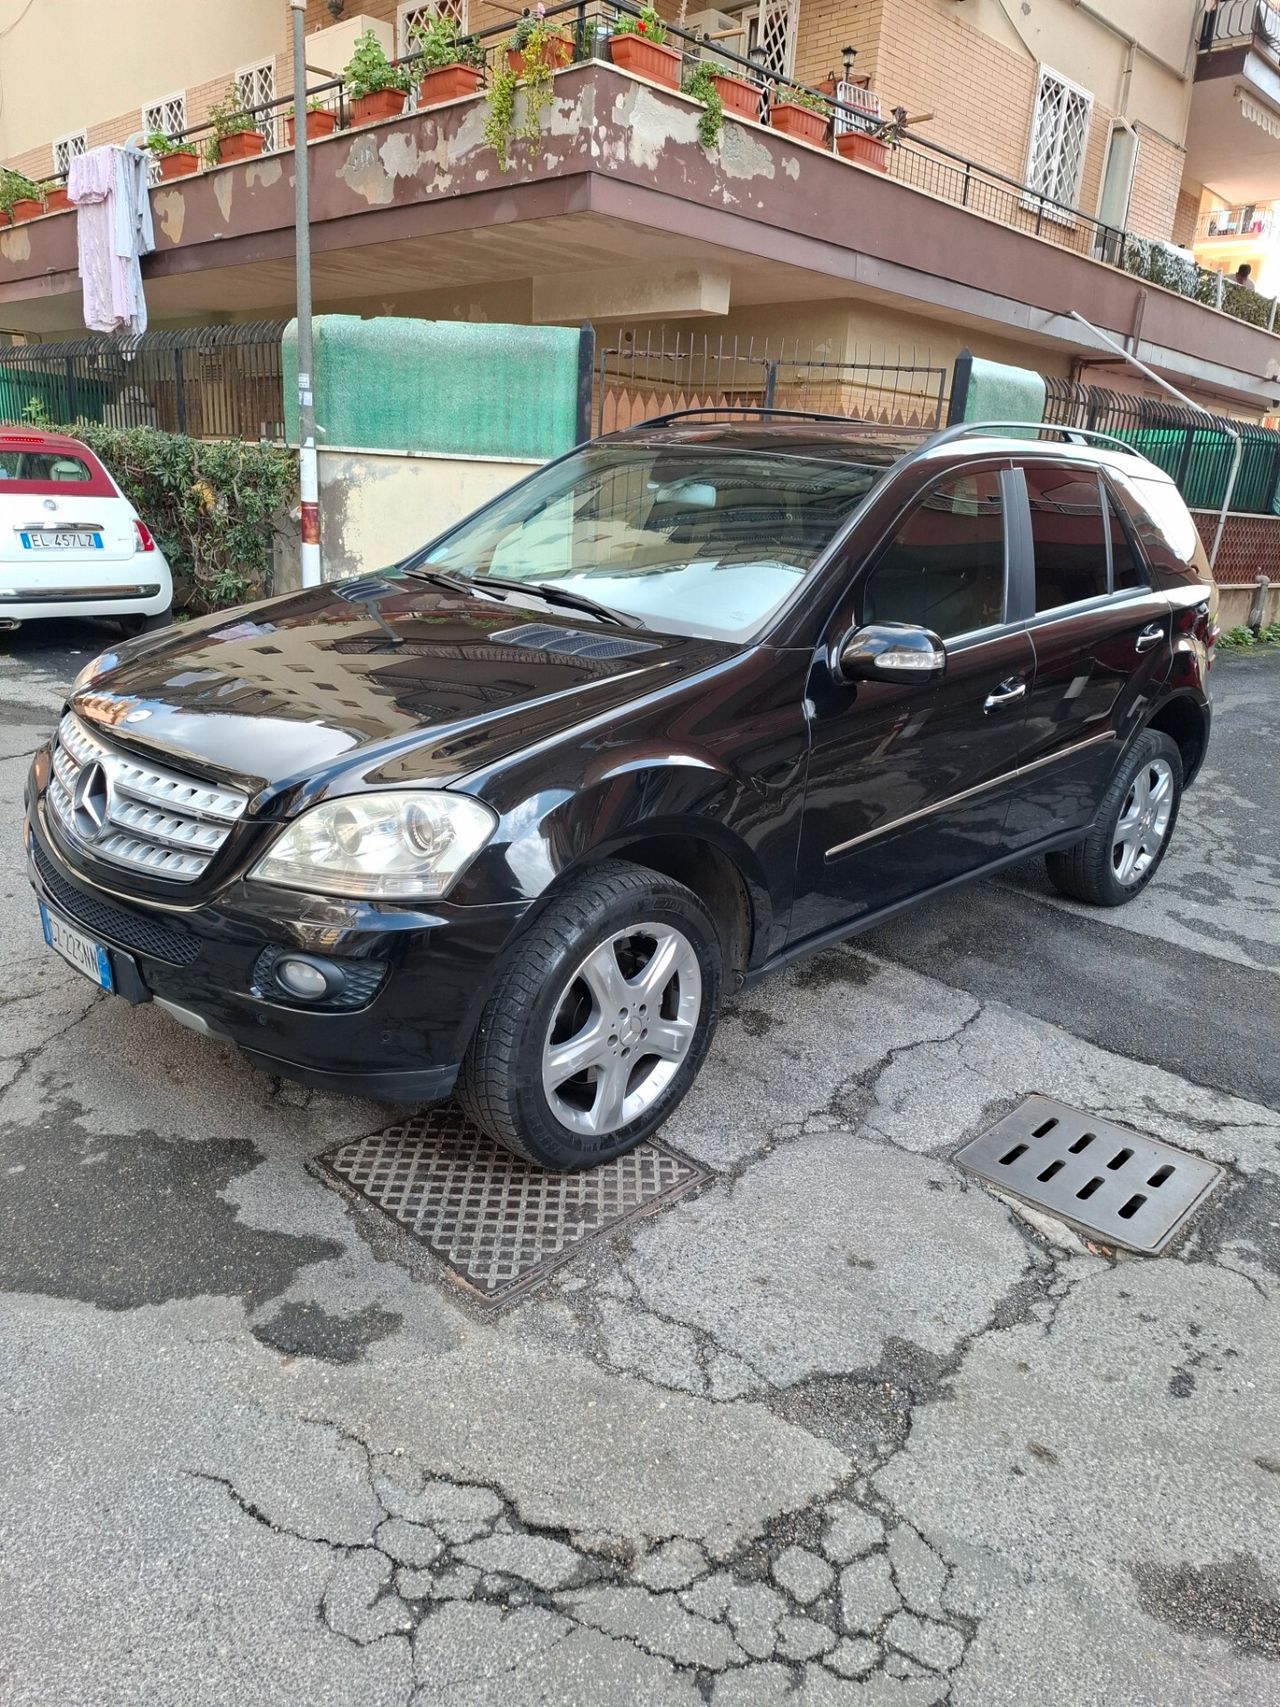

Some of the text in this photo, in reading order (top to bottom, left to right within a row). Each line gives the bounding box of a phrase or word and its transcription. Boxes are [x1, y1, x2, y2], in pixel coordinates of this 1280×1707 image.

[31, 534, 94, 547] EL 457LZ
[63, 930, 99, 975] 223NN
